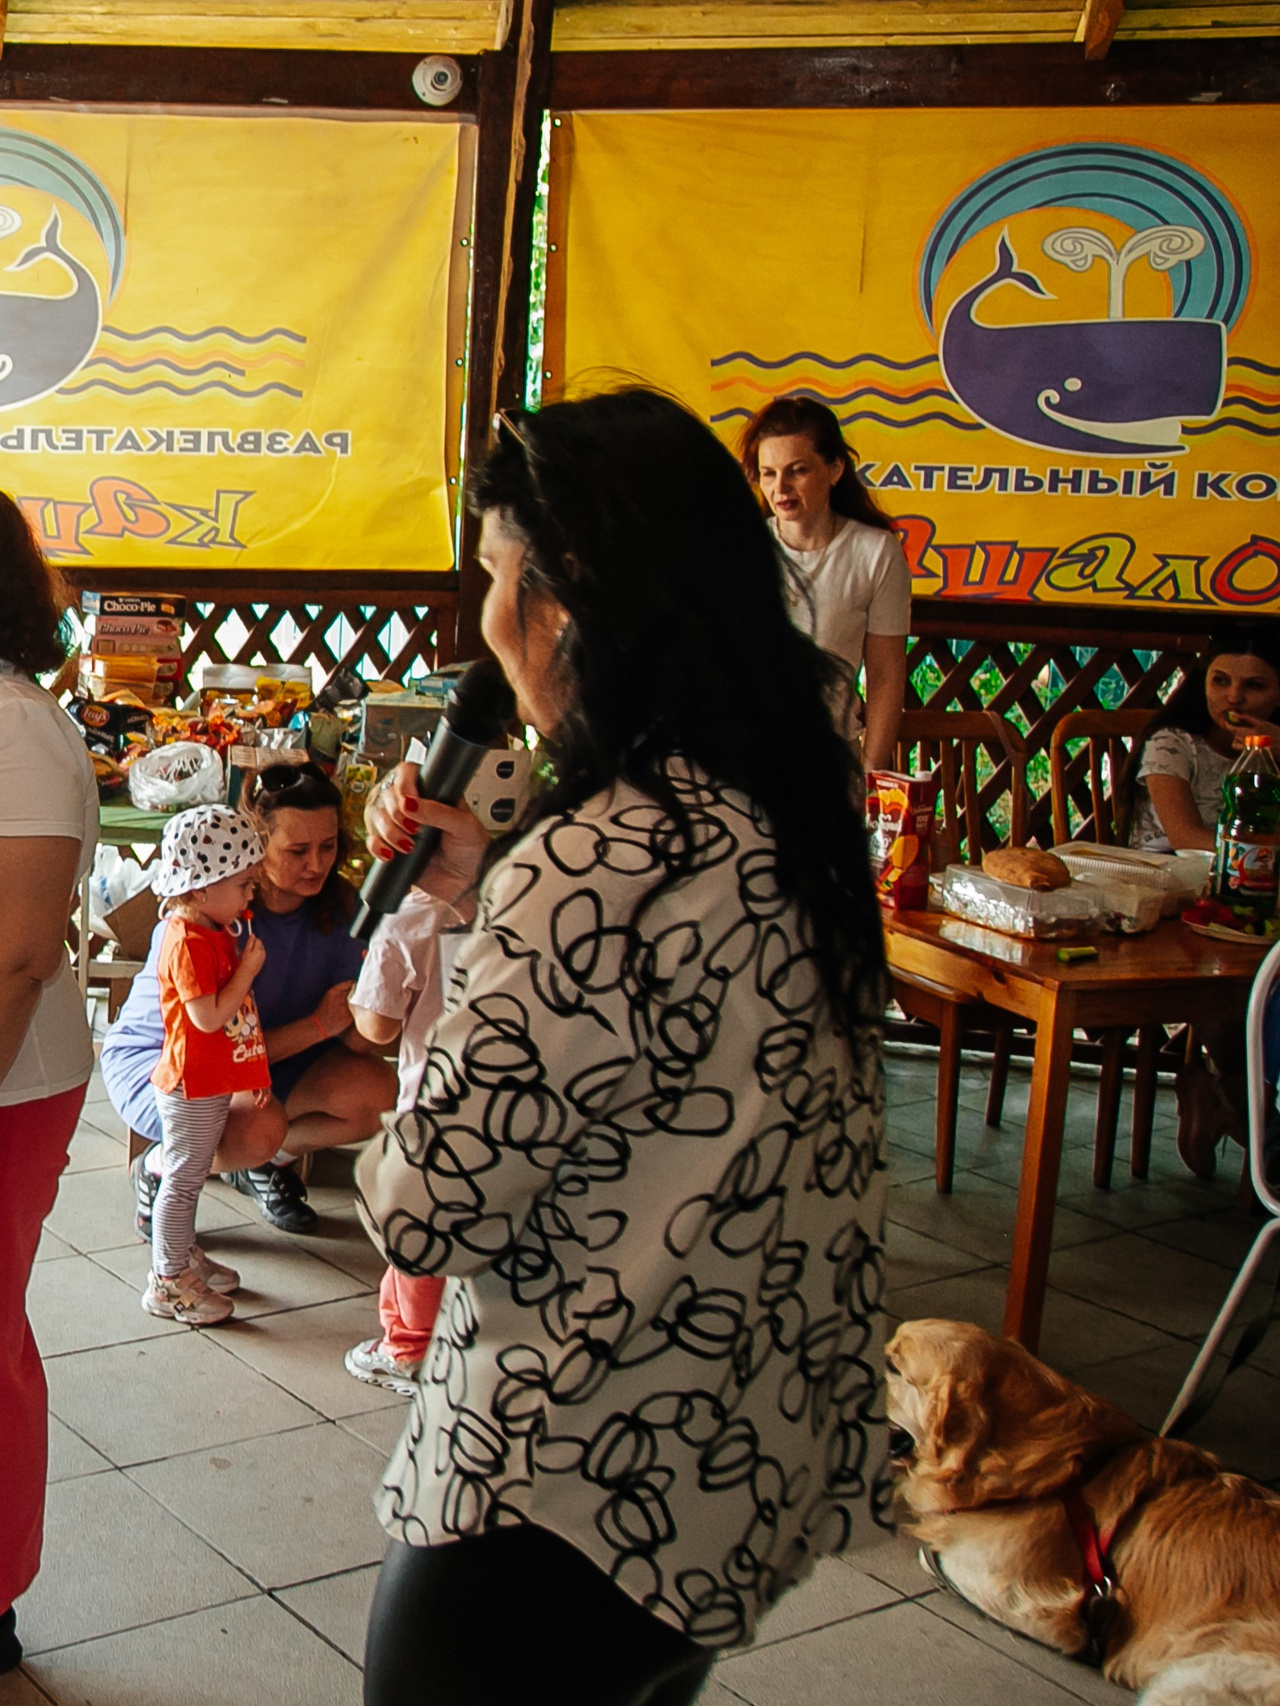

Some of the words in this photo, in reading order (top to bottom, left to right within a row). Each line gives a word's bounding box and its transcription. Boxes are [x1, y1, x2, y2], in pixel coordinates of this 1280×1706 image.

[855, 461, 1178, 499] КАТЕЛЬНЫЙ
[1194, 471, 1280, 501] КО
[888, 514, 1280, 607] ашало
